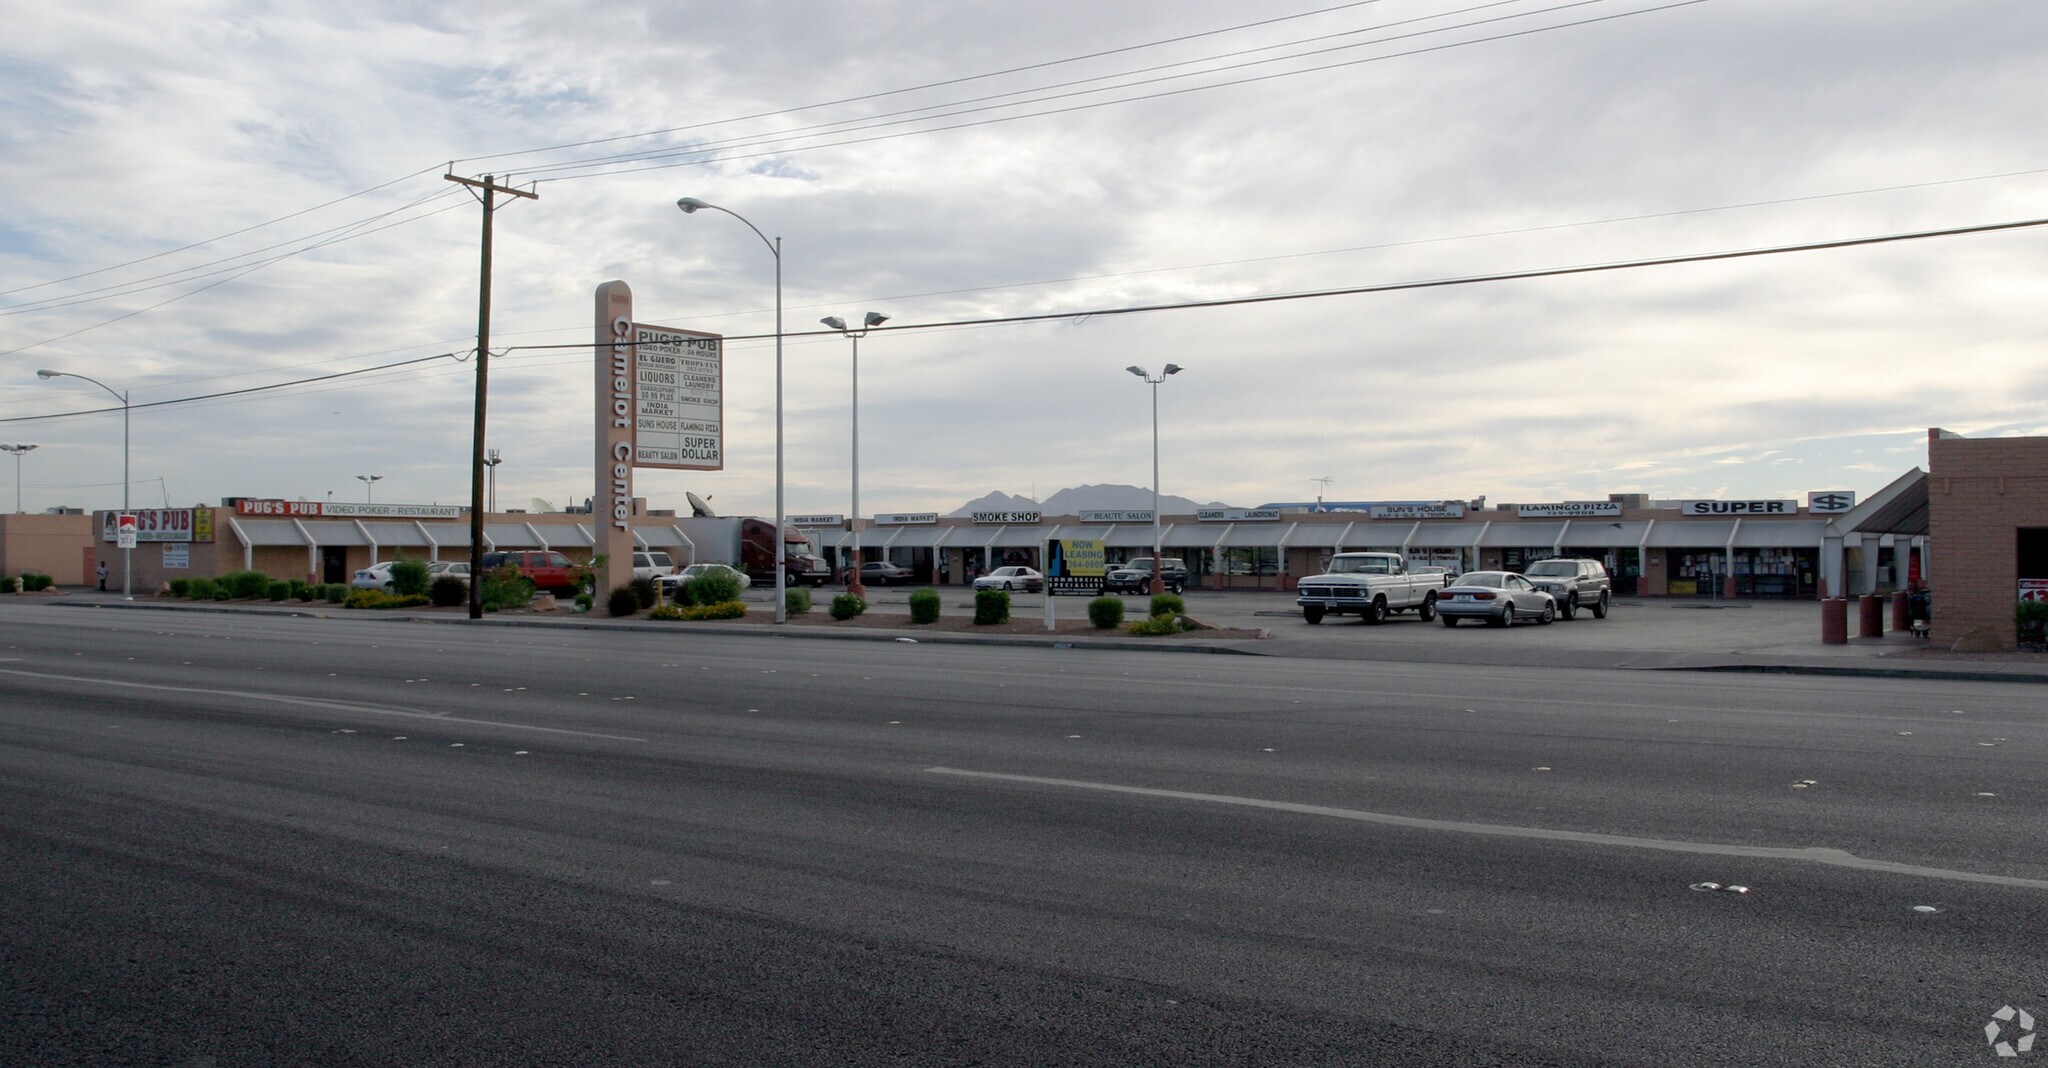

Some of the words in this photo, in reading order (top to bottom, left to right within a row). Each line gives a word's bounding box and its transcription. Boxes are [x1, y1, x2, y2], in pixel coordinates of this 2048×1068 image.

[639, 331, 682, 347] PUG'S
[687, 337, 717, 351] PUB
[639, 344, 658, 352] VIDEO
[660, 345, 680, 354] POKER
[687, 348, 695, 356] 24
[696, 350, 717, 359] HOURS
[613, 316, 632, 428] Camelot
[640, 371, 675, 384] LIQUORS
[683, 374, 716, 384] CLEANERS
[685, 381, 714, 390] LAUNDRY
[660, 392, 674, 401] PLUS
[681, 395, 701, 404] SMOKE
[703, 397, 718, 405] SHOP
[641, 408, 673, 416] MARKET
[657, 420, 677, 430] HOUSE
[680, 422, 704, 432] FLAMINGO
[705, 423, 719, 433] PIZZA
[684, 437, 716, 449] SUPER
[638, 450, 658, 460] BEAUTY
[660, 451, 678, 460] SALON
[682, 449, 718, 461] DOLLAR
[614, 441, 632, 532] Center
[243, 500, 284, 514] PUG'S
[290, 502, 318, 514] PUB
[326, 505, 354, 514] VIDEO
[358, 506, 389, 515] POKER
[397, 507, 455, 516] RESTAURANT
[1520, 504, 1580, 512] FLAMINGO
[1694, 502, 1784, 514] SUPER
[162, 510, 189, 531] PUB
[972, 512, 1008, 523] SMOKE
[1011, 512, 1040, 522] SHOP
[1127, 511, 1152, 520] SALON
[1072, 541, 1094, 549] NOW
[1064, 551, 1103, 559] LEASING
